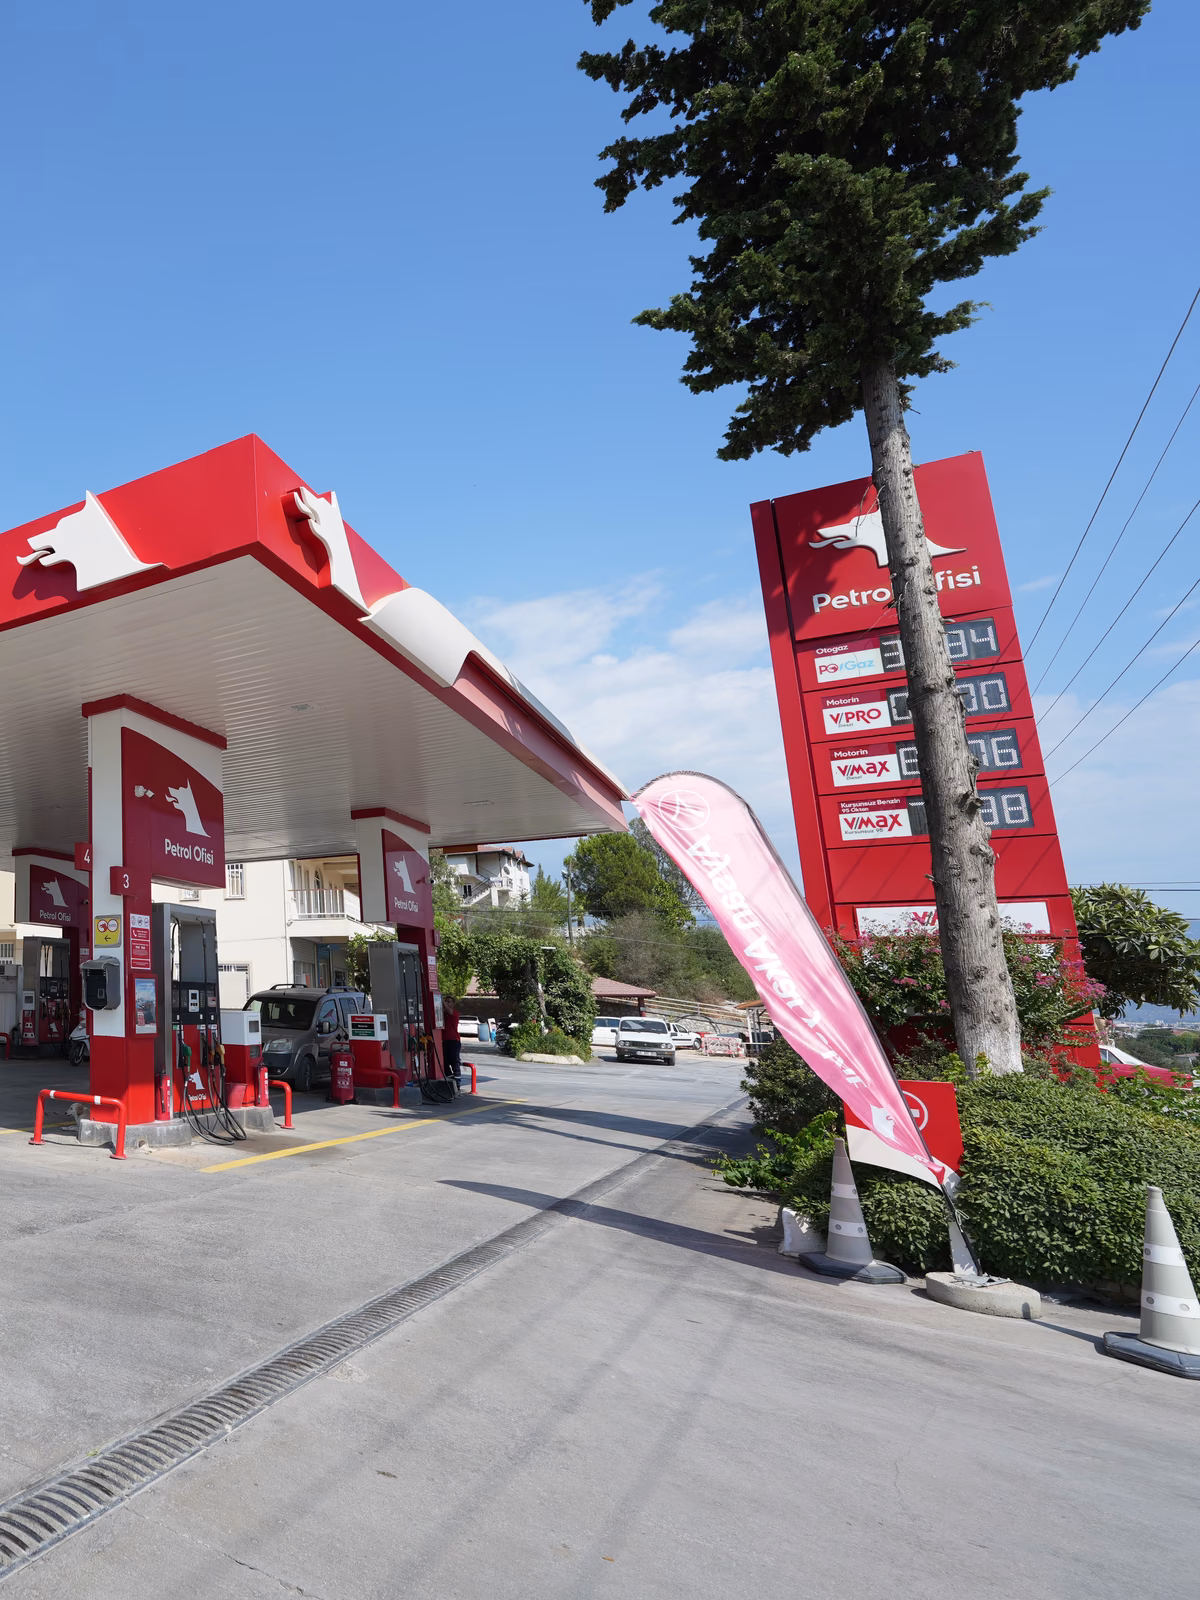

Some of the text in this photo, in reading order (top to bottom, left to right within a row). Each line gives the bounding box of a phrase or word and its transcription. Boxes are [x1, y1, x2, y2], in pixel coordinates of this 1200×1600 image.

[812, 565, 981, 614] Petro fisi
[815, 645, 849, 655] Otogaz
[826, 697, 860, 706] Motorin
[833, 749, 868, 758] Motorin
[877, 798, 901, 806] Benzin
[83, 849, 91, 864] 4
[164, 838, 214, 866] Petrol Ofisi
[123, 873, 130, 889] 3
[394, 897, 419, 913] Petrol Ofisi
[39, 909, 71, 922] Petrol Ofisi
